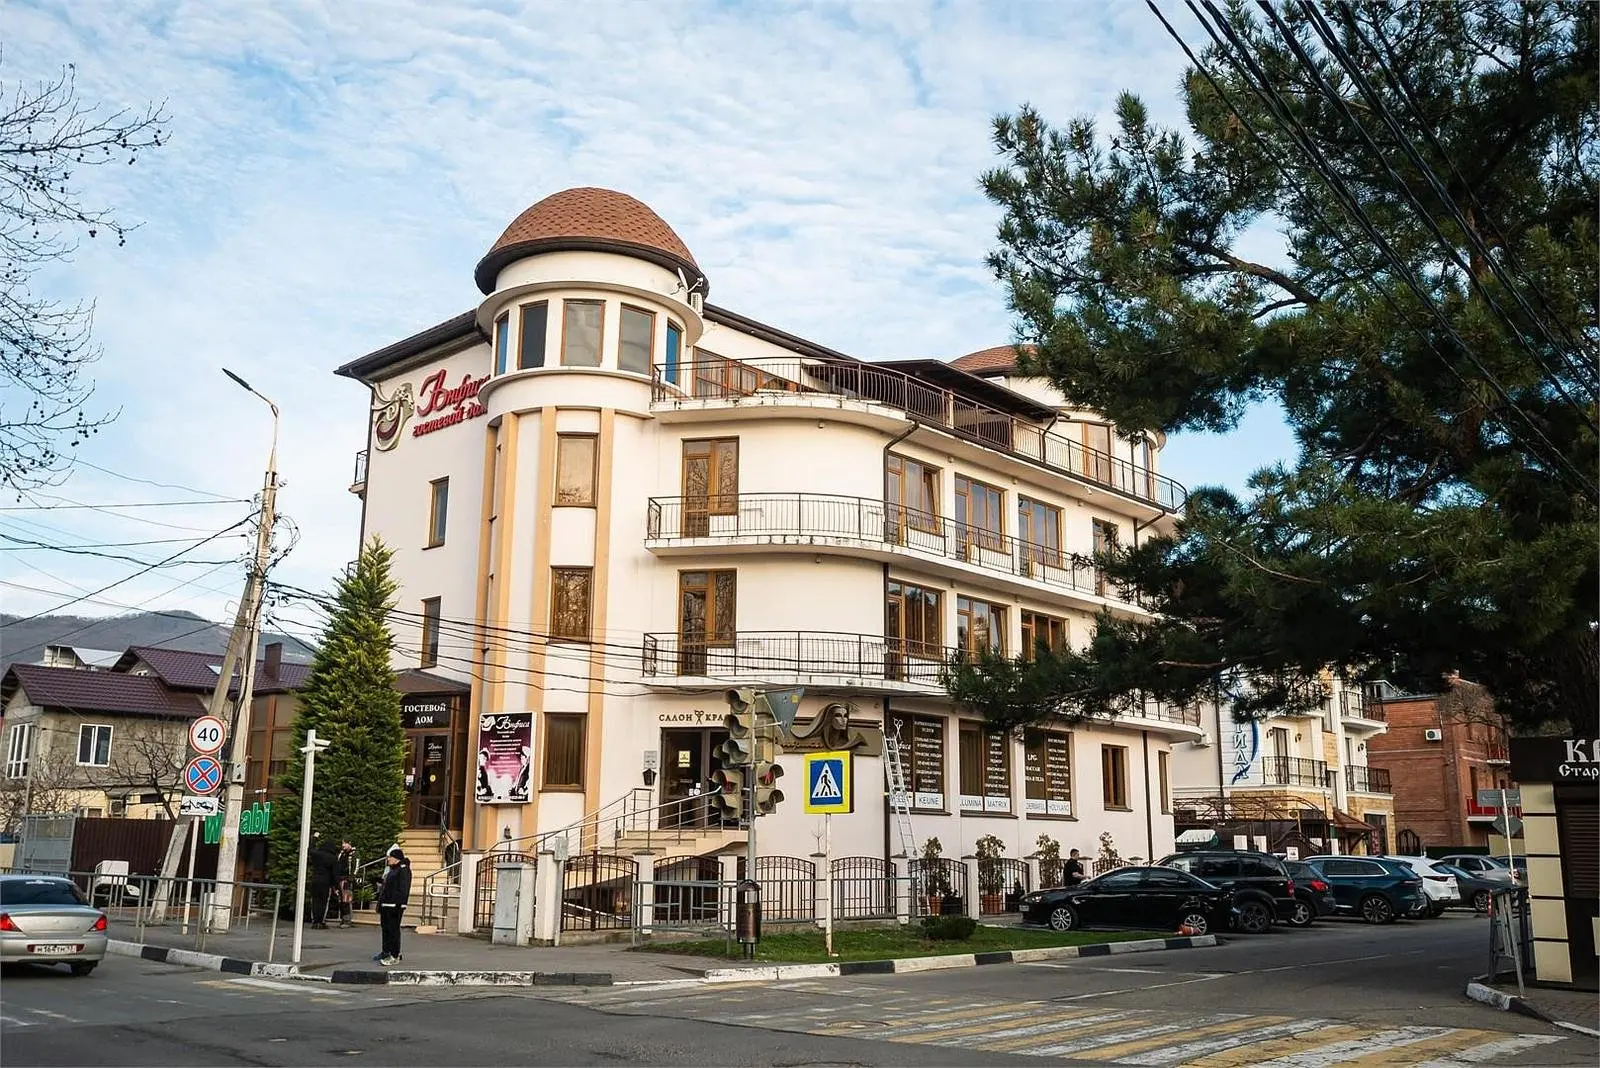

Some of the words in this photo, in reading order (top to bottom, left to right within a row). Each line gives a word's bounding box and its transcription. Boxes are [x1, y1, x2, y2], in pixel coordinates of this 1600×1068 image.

[404, 702, 446, 713] ГОСТЕВОЙ
[415, 716, 433, 725] ДОМ
[659, 714, 693, 722] САЛОН
[197, 727, 219, 742] 40
